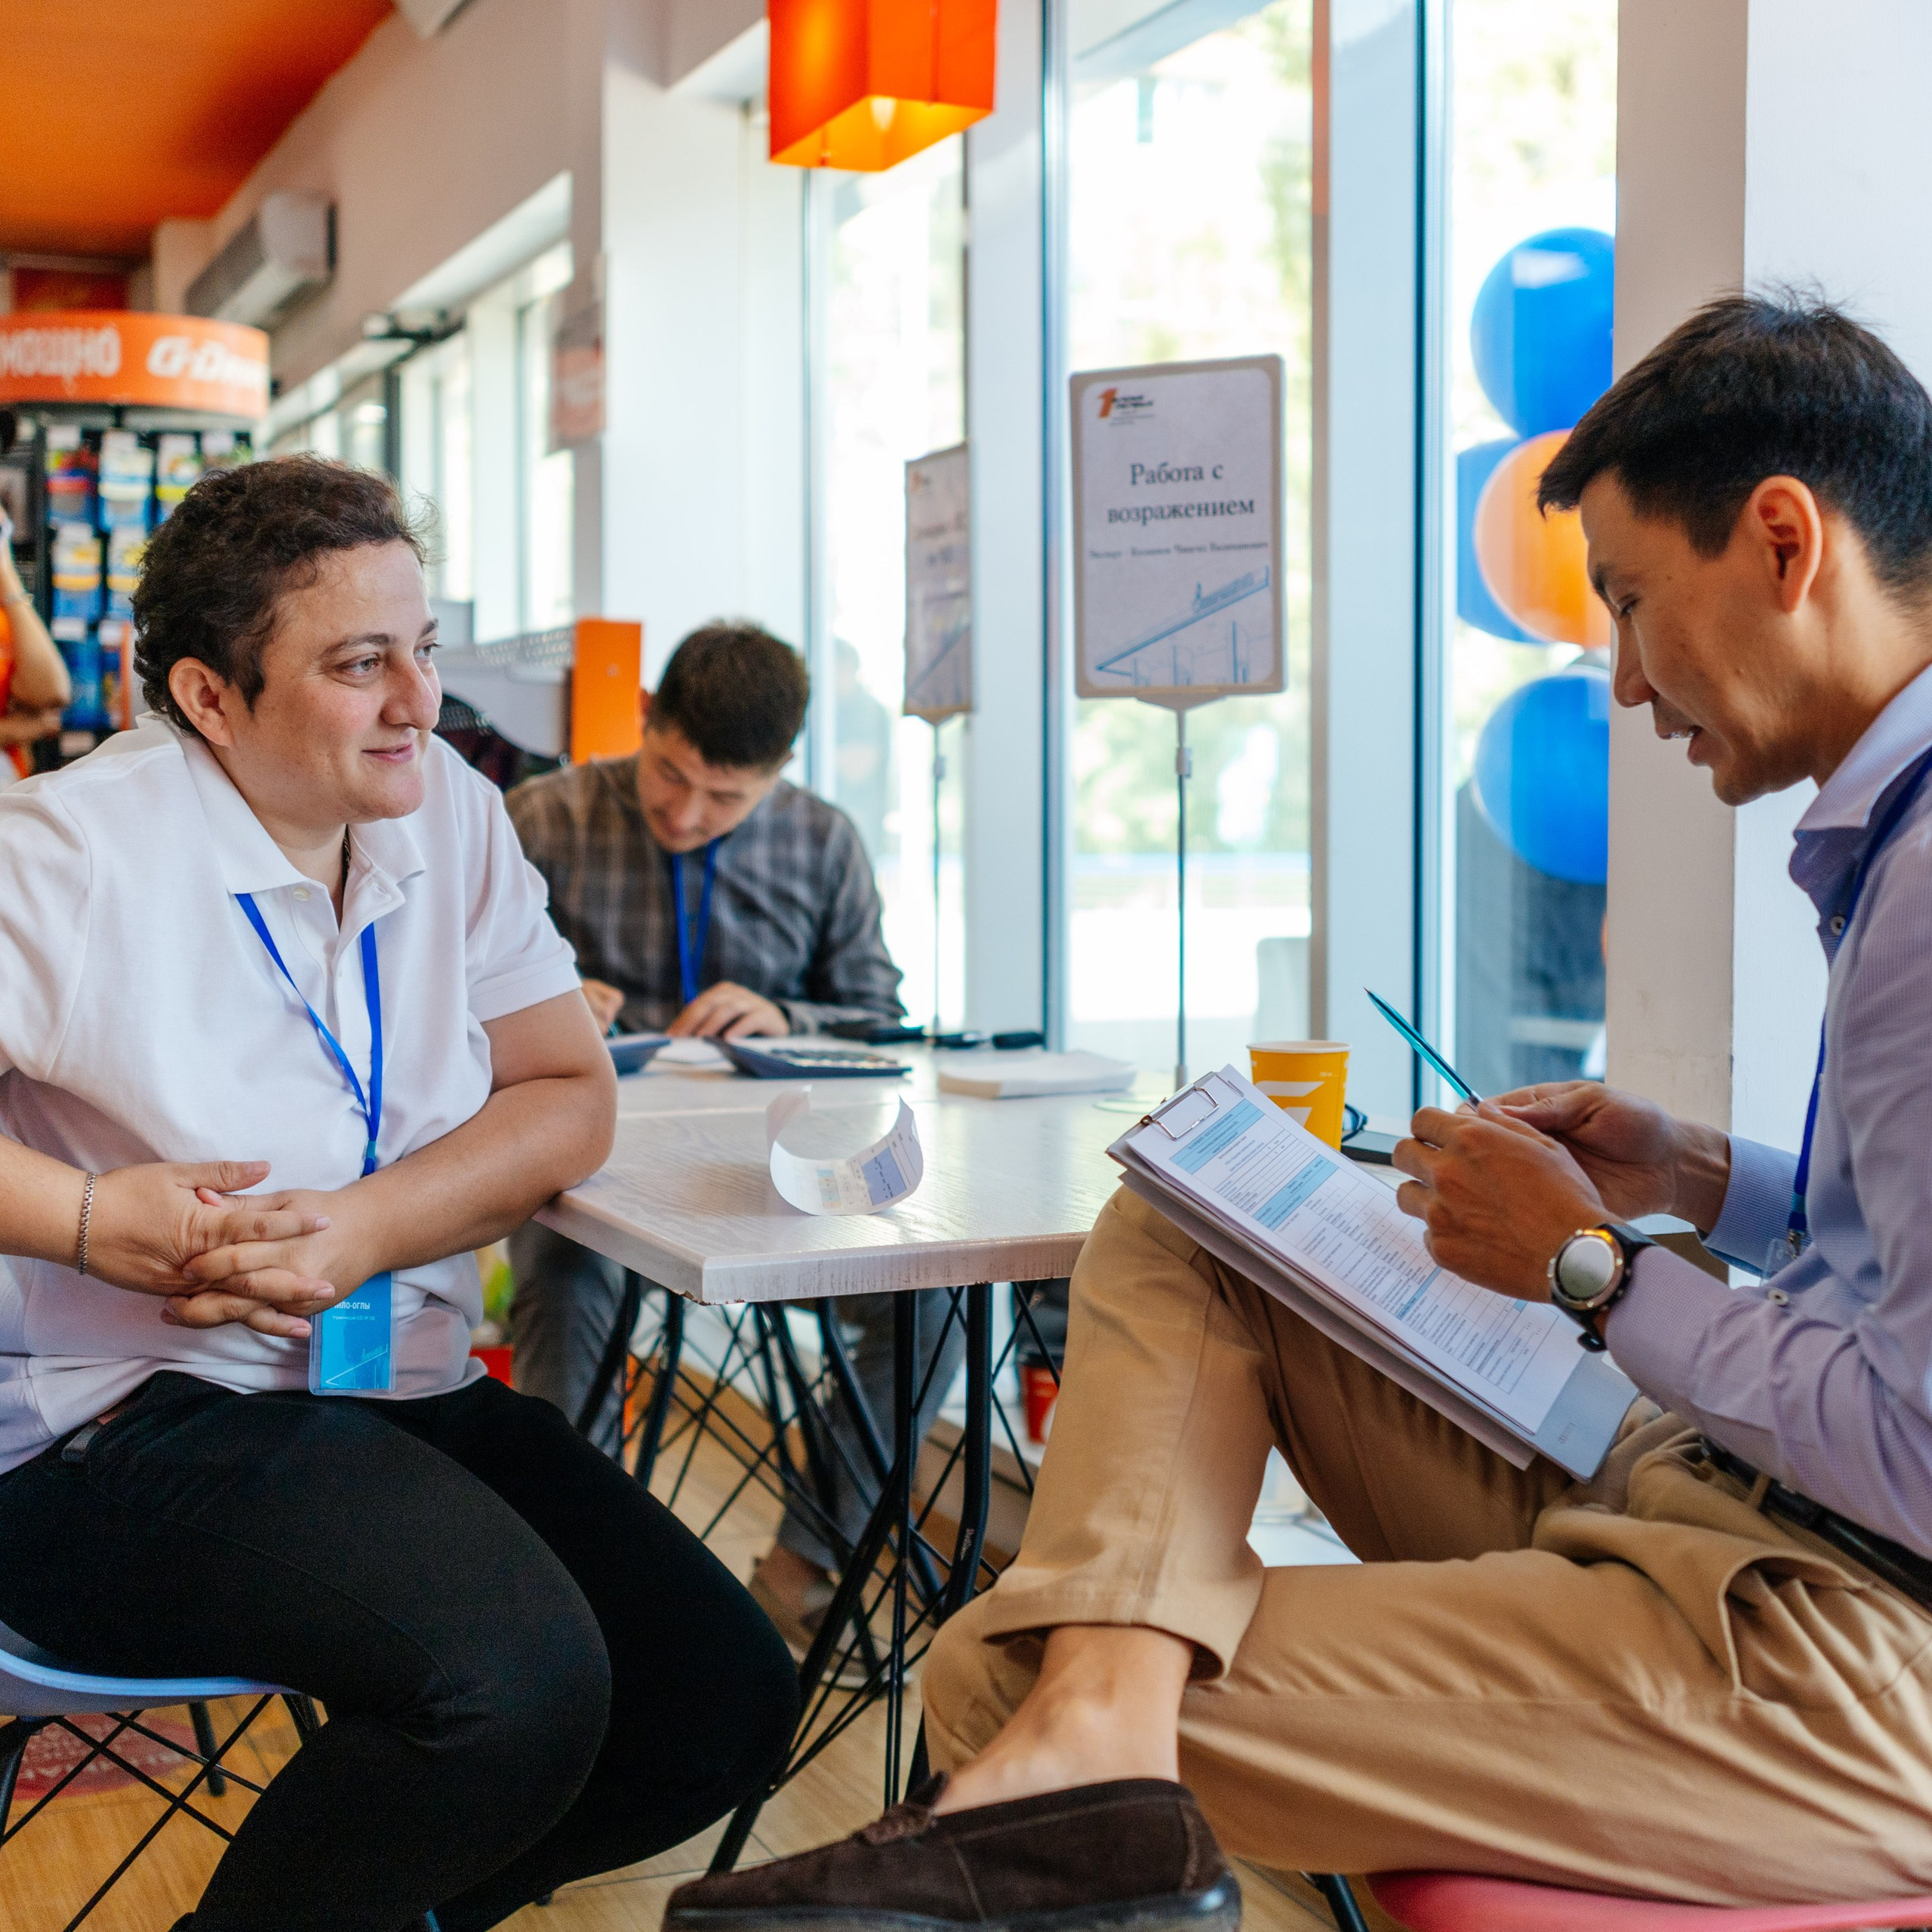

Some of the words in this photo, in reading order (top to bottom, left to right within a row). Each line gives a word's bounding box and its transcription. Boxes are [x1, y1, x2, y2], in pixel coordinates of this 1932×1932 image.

[1131, 461, 1204, 485] Работа
[1212, 463, 1224, 480] с
[1107, 498, 1255, 527] возражением
